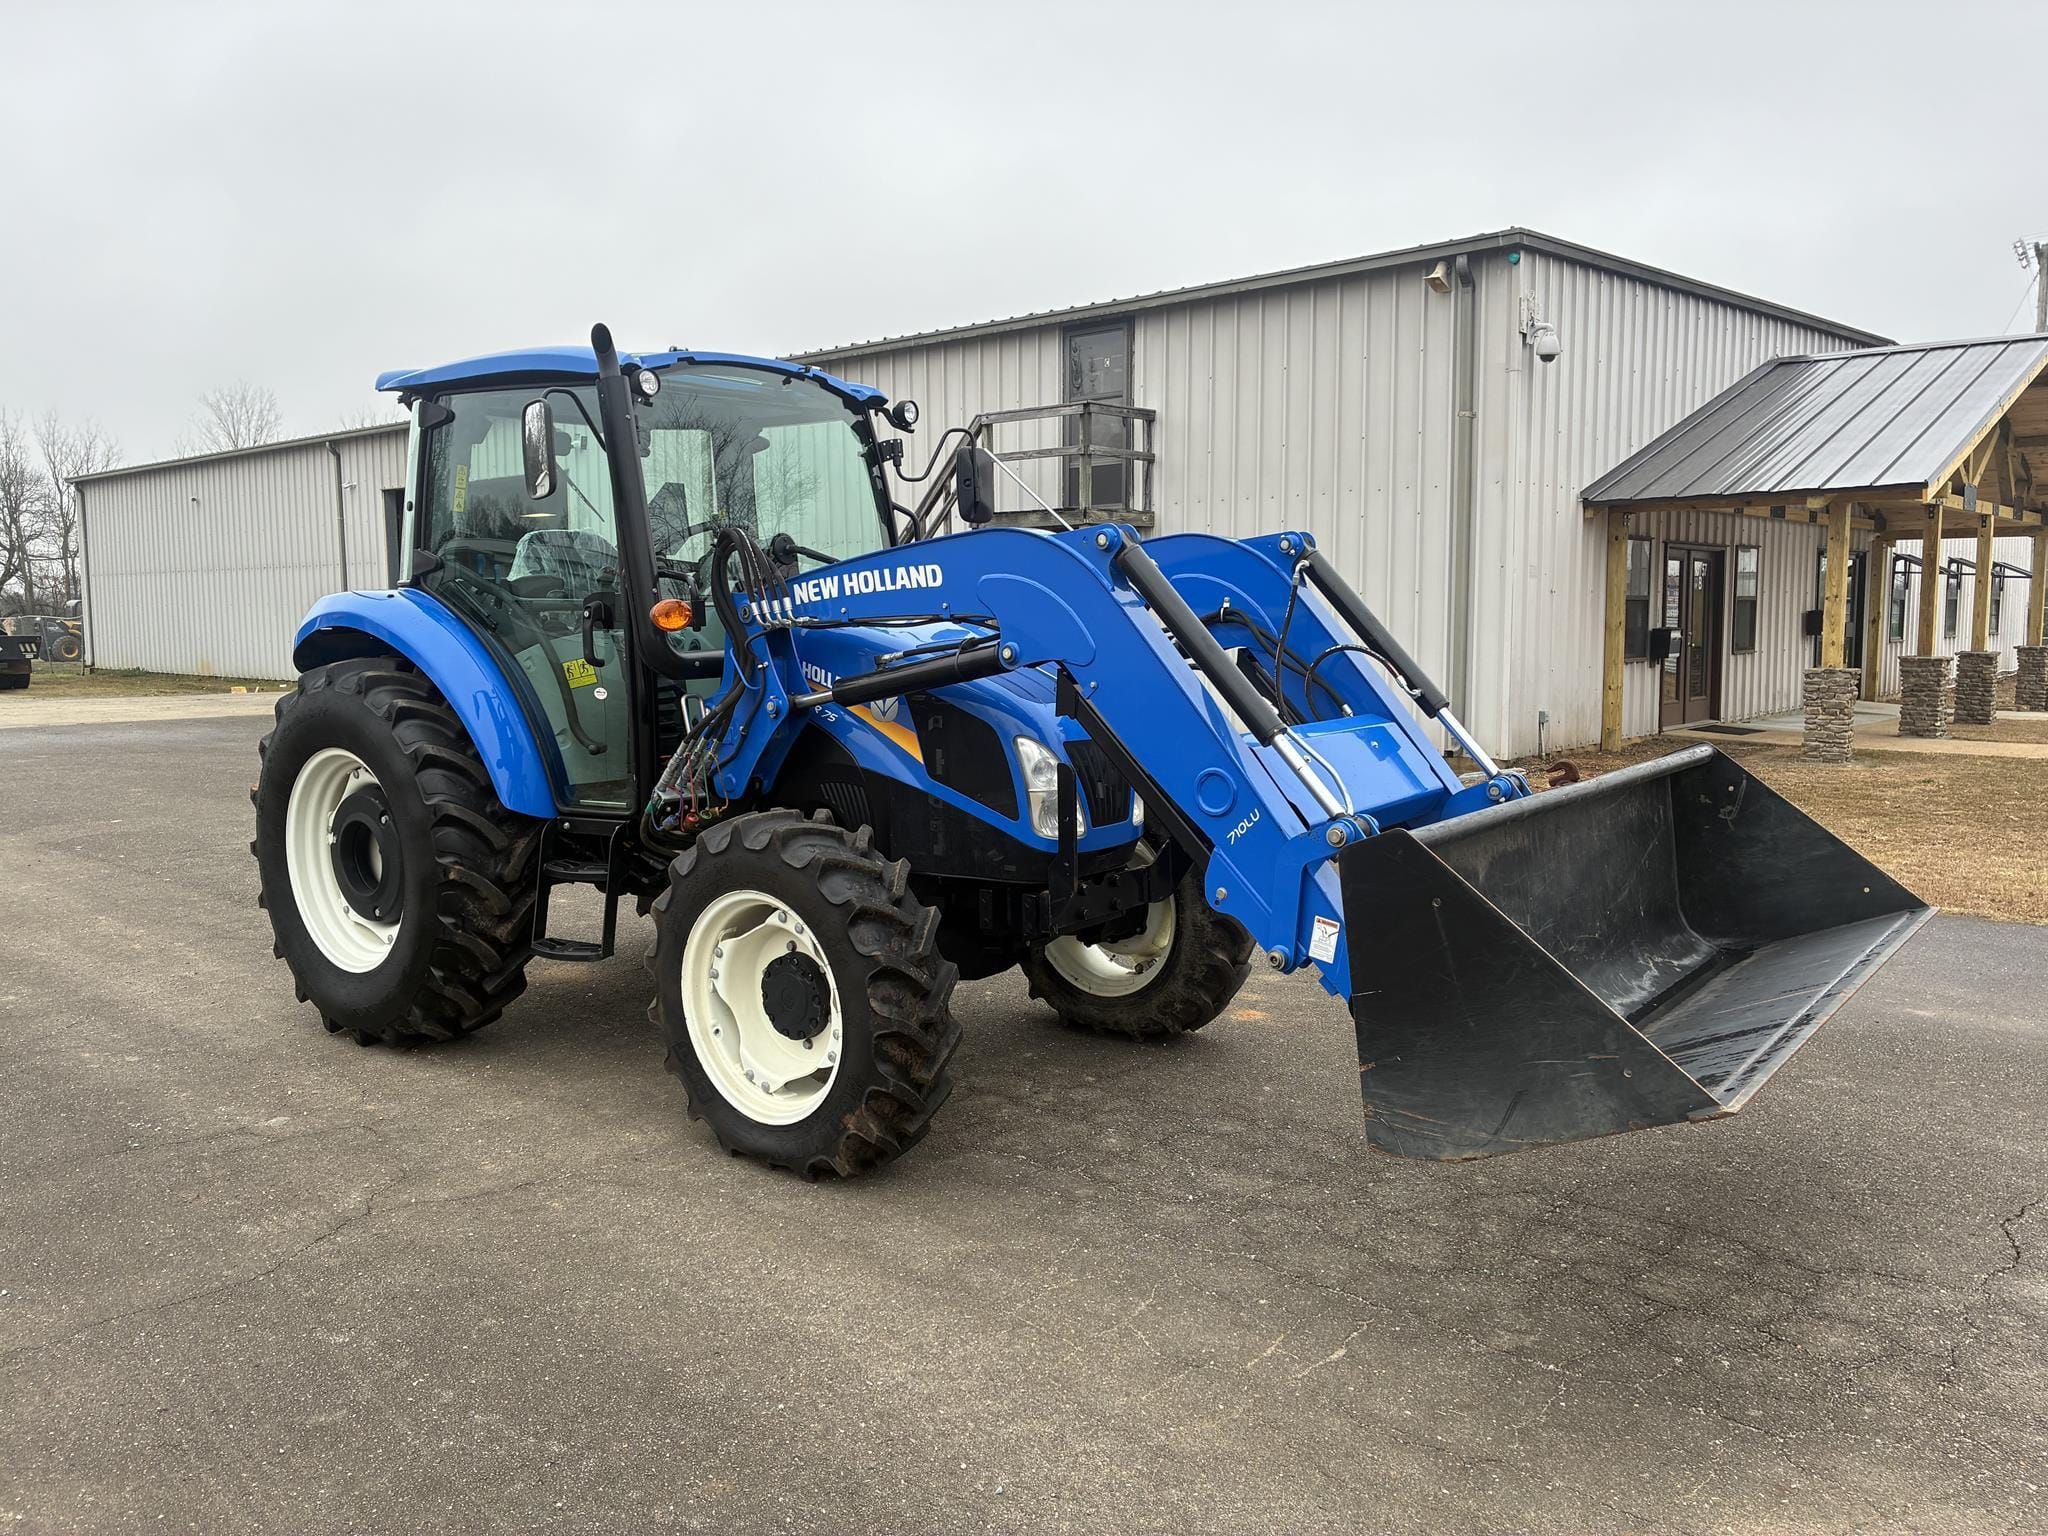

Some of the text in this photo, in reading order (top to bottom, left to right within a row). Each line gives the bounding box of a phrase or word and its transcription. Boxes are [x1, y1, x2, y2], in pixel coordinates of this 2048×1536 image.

[793, 564, 943, 605] NEW HOLLAND
[802, 660, 841, 689] HOLL
[821, 709, 839, 722] 75
[1226, 808, 1260, 845] 710LU
